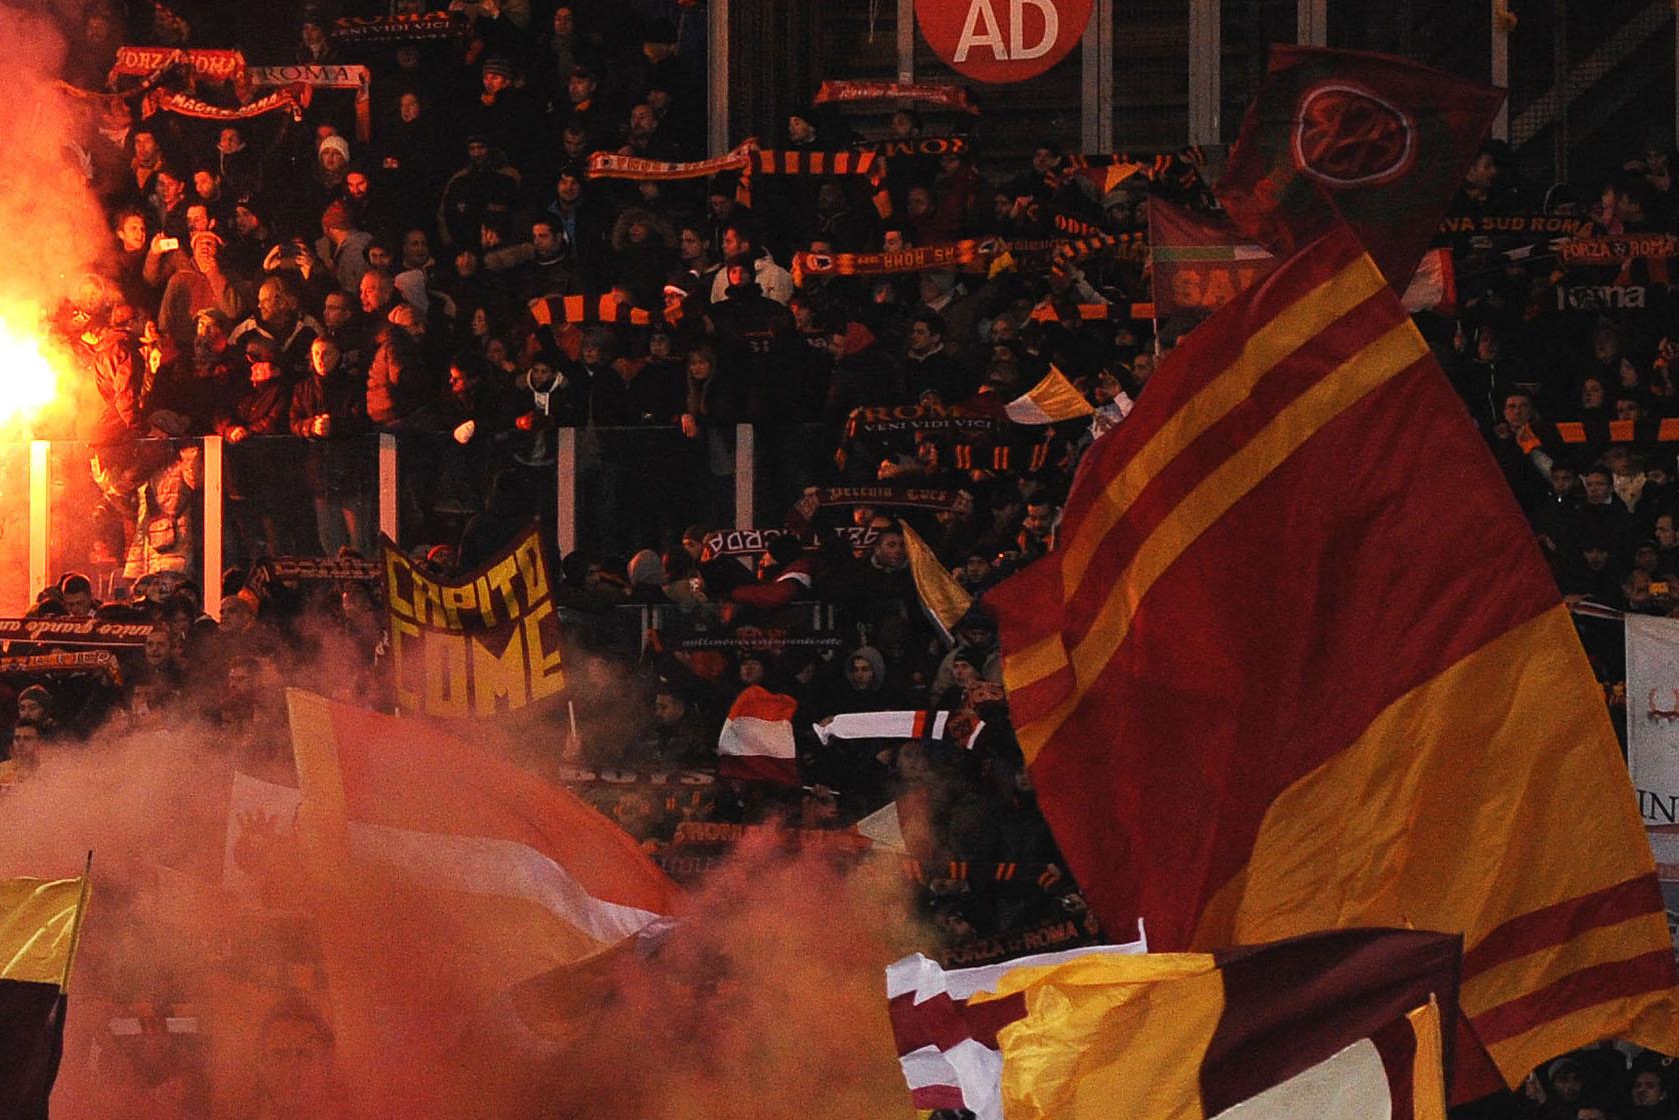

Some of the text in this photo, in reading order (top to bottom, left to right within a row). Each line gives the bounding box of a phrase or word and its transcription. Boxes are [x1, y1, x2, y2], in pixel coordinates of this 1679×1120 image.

[953, 0, 1059, 62] AD
[263, 66, 349, 81] ROMA
[1481, 217, 1522, 232] SUD
[384, 531, 550, 631] CAPITO
[25, 618, 96, 641] grande
[100, 622, 156, 639] unico
[1024, 921, 1079, 947] ROMA
